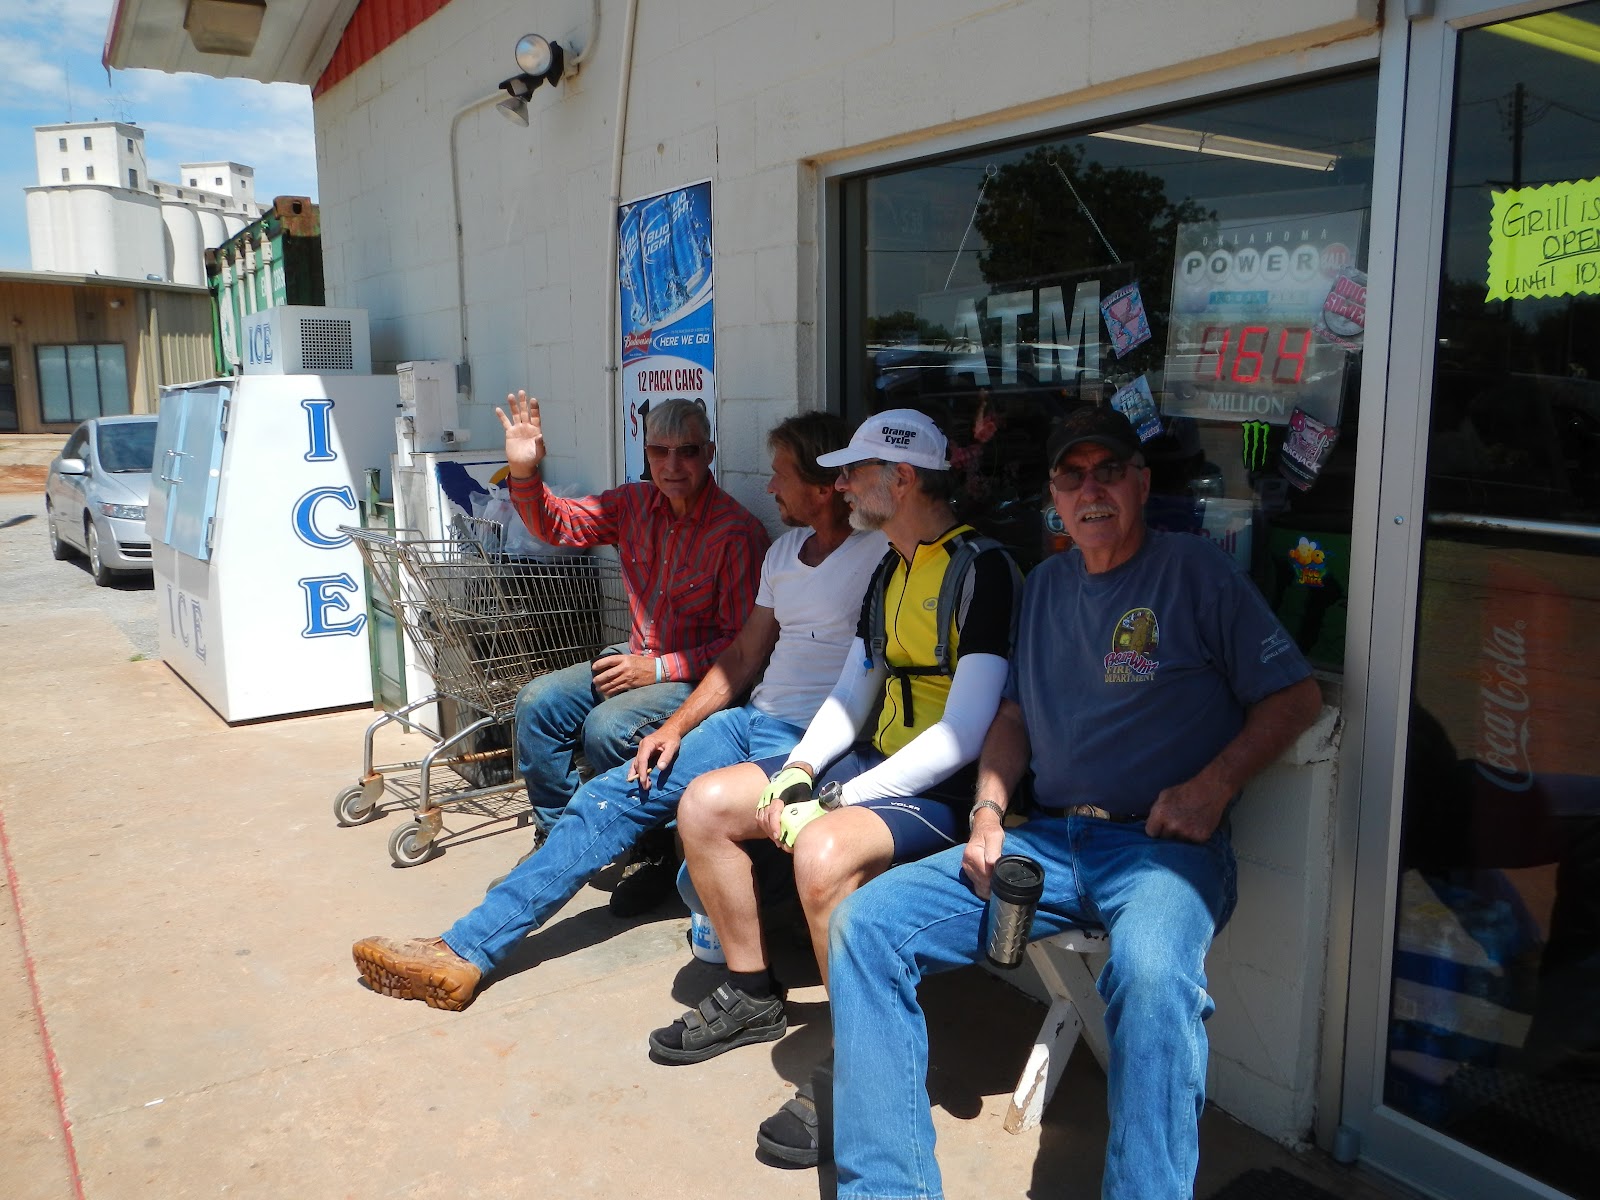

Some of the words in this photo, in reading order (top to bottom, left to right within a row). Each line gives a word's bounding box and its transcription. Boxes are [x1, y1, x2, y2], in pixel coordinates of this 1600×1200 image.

[646, 223, 670, 245] BUD
[1202, 228, 1328, 246] OKLAHOMA
[1185, 252, 1315, 276] POWER
[1333, 274, 1367, 305] QUIC
[1324, 291, 1367, 328] SILVE
[248, 322, 273, 365] ICE
[660, 336, 679, 347] HERE
[681, 335, 694, 345] WE
[695, 333, 710, 344] GO
[949, 280, 1101, 386] ATM
[1215, 327, 1312, 383] 164
[637, 371, 647, 392] 12
[648, 370, 673, 391] PACK
[675, 367, 703, 391] CANS
[1208, 393, 1285, 415] MILLION
[882, 426, 917, 438] Orange
[885, 435, 911, 445] Cycle
[291, 398, 368, 640] ICE
[166, 583, 207, 666] ICE
[1104, 672, 1155, 683] DEPARTMENT
[1106, 665, 1132, 674] FIRE
